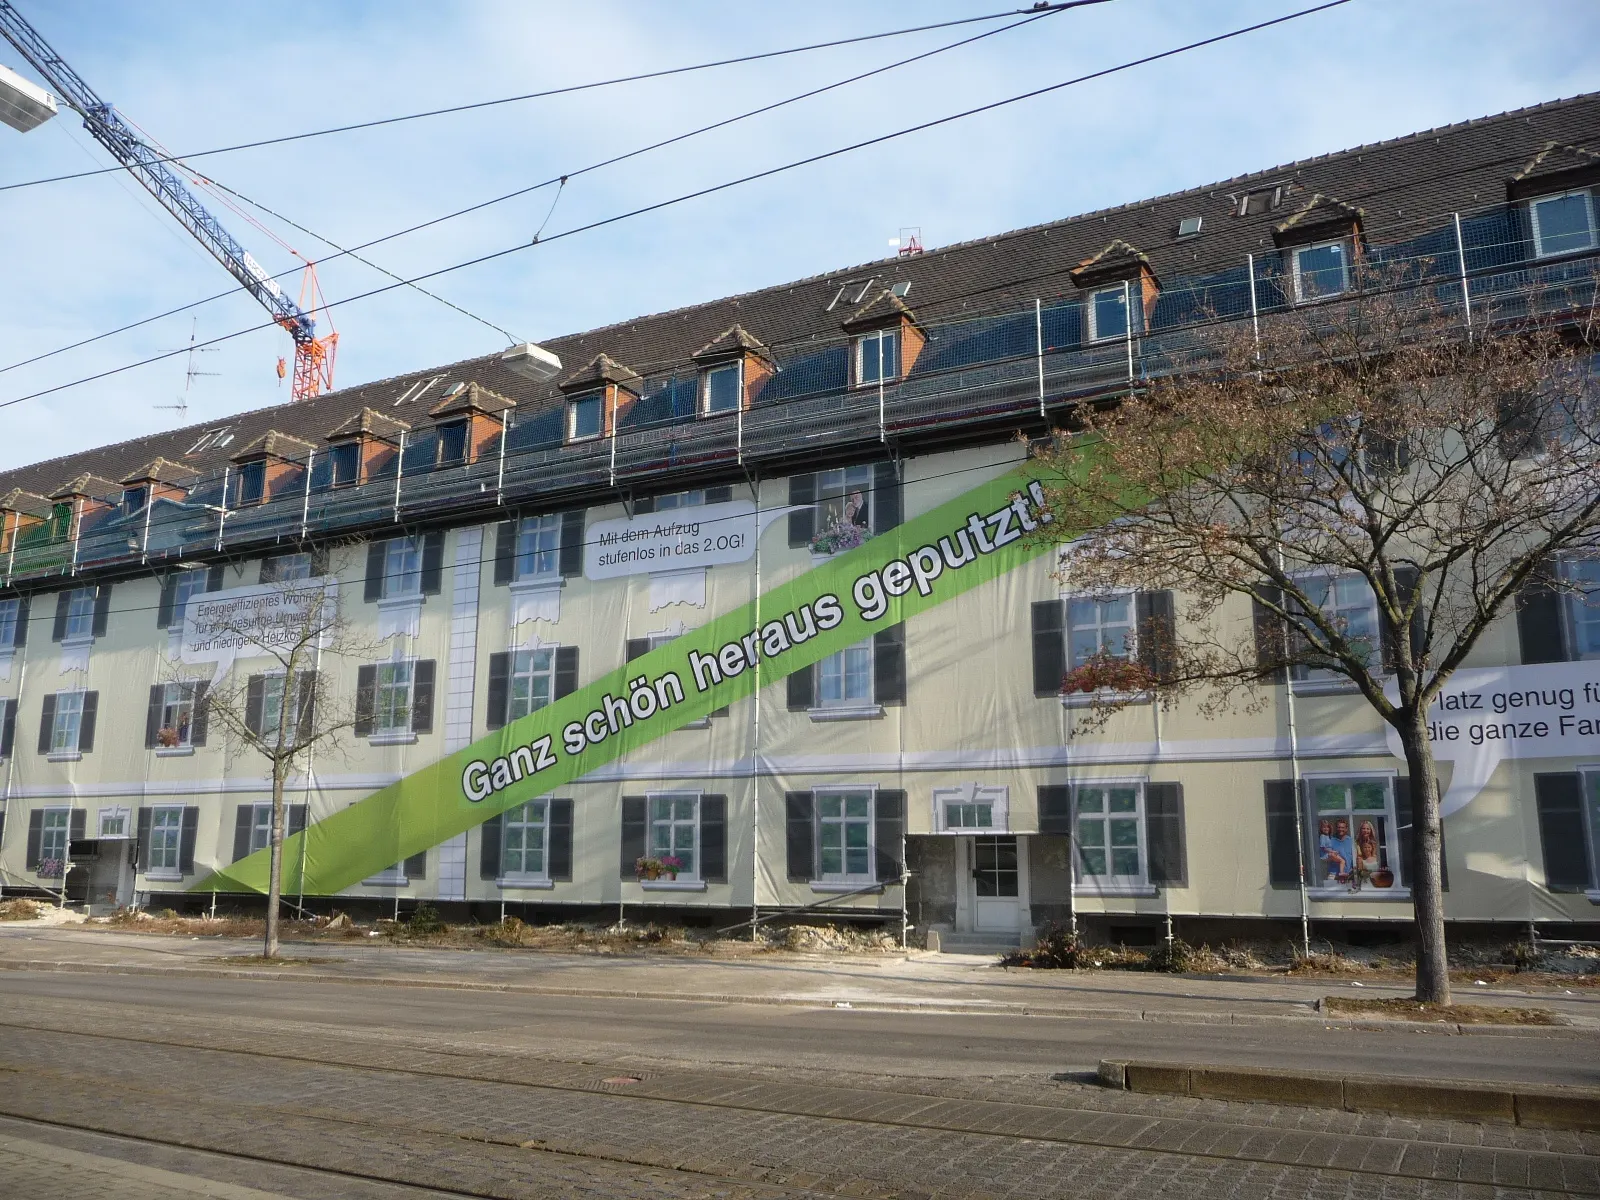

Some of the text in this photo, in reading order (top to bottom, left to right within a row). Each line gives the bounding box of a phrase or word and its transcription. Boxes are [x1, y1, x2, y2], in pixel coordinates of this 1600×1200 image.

[598, 522, 700, 547] Mit dem Aufzug
[598, 534, 745, 566] stufenlos in das 2.OG!
[197, 595, 280, 617] Energieeffizientes
[193, 640, 211, 652] und
[462, 479, 1055, 802] Ganz schön heraus geputzt!
[1431, 690, 1484, 711] latz
[1491, 688, 1574, 714] genug
[1427, 720, 1460, 742] die
[1468, 719, 1549, 746] ganze
